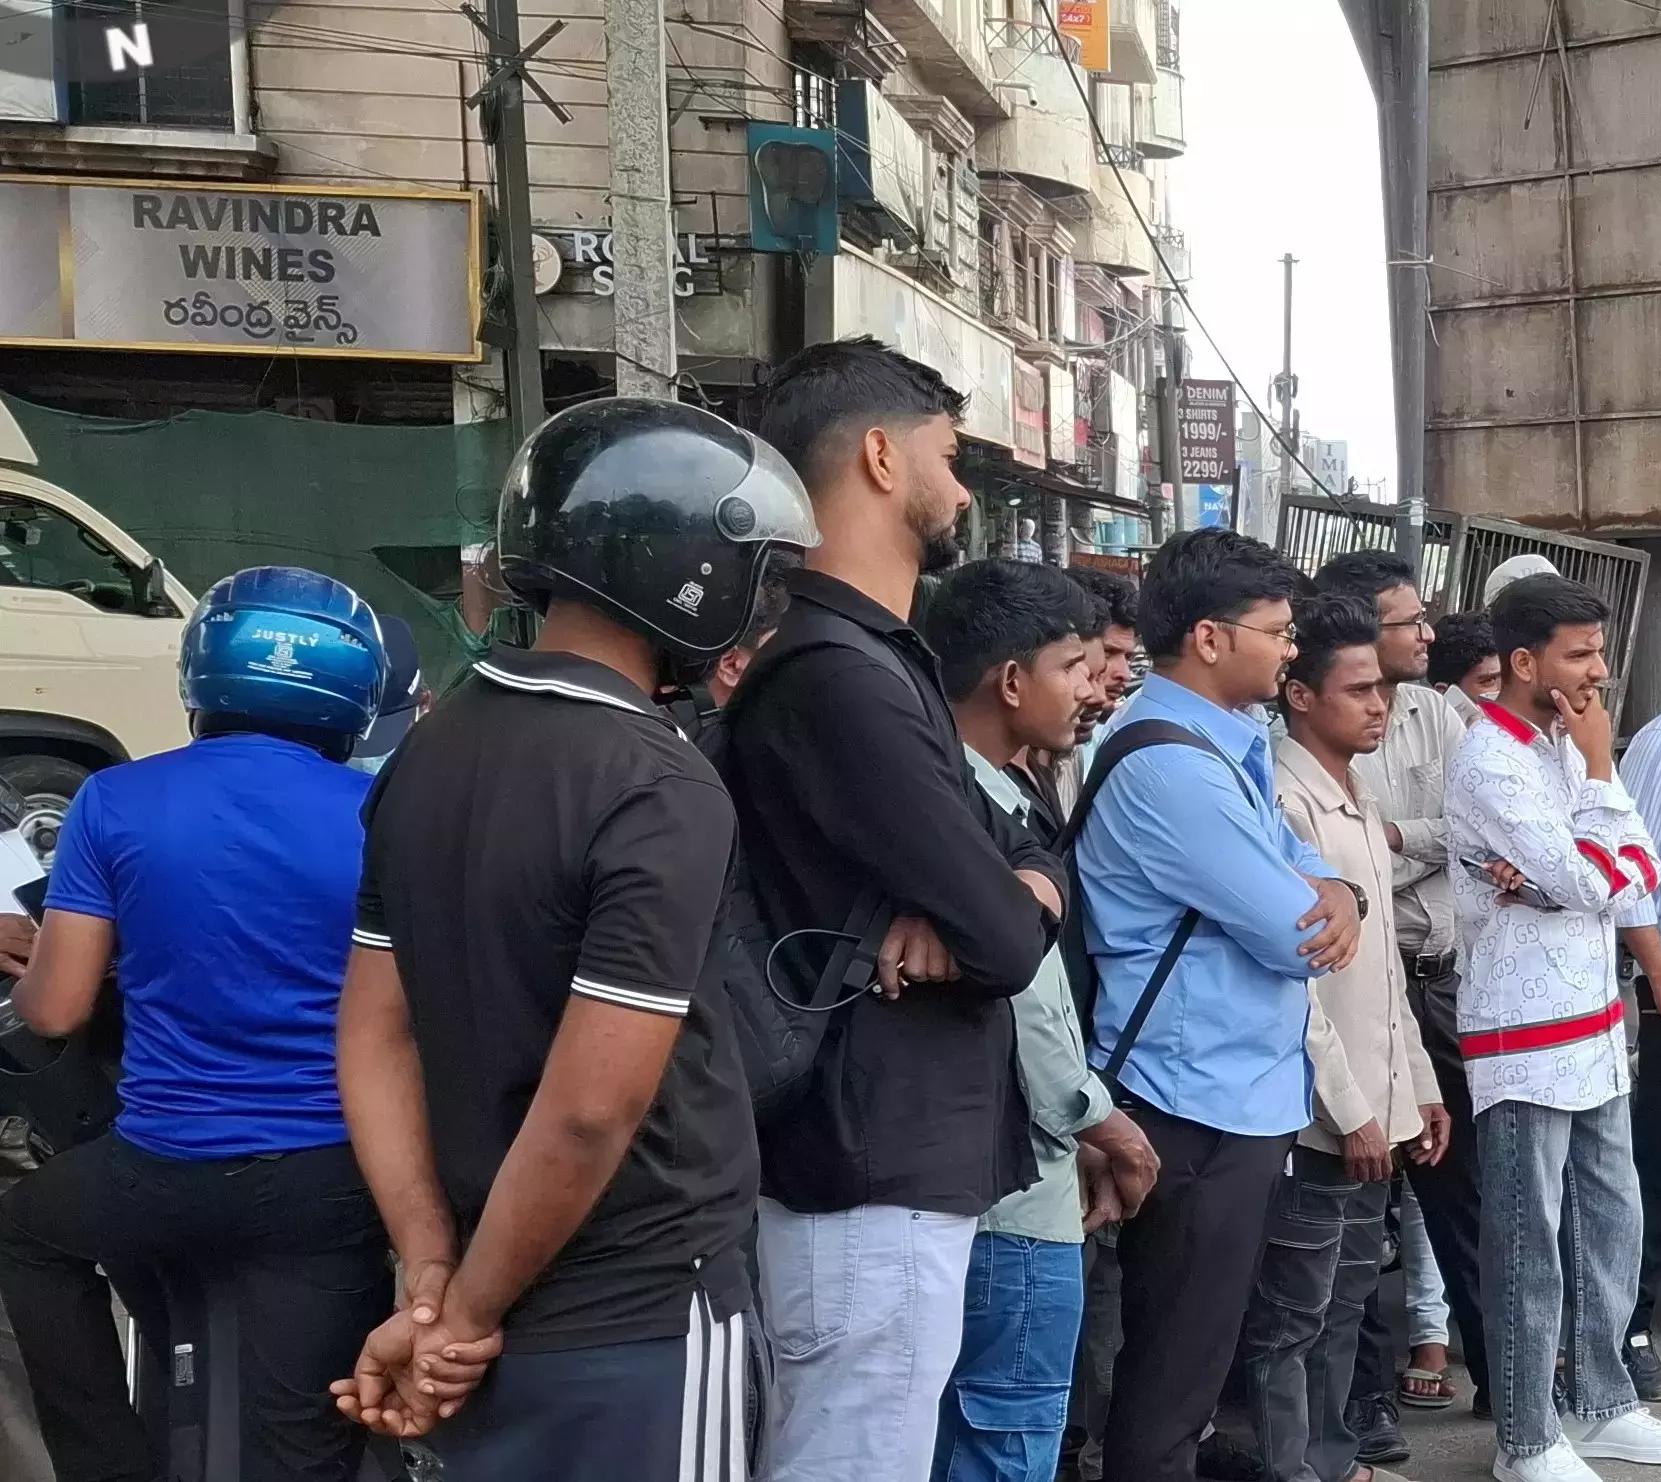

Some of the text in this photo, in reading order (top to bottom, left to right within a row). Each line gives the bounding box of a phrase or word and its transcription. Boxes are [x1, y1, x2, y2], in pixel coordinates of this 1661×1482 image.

[132, 193, 382, 237] RAVINDRA
[178, 244, 336, 283] WINES
[592, 265, 695, 297] SG
[163, 290, 359, 345] రవీంద్ర వైన్స్
[1185, 408, 1218, 421] SHIRTS
[1181, 422, 1227, 442] 1999/-
[1189, 446, 1218, 459] JEANS
[1183, 460, 1229, 480] 2299/-
[251, 628, 320, 648] JUSTLY
